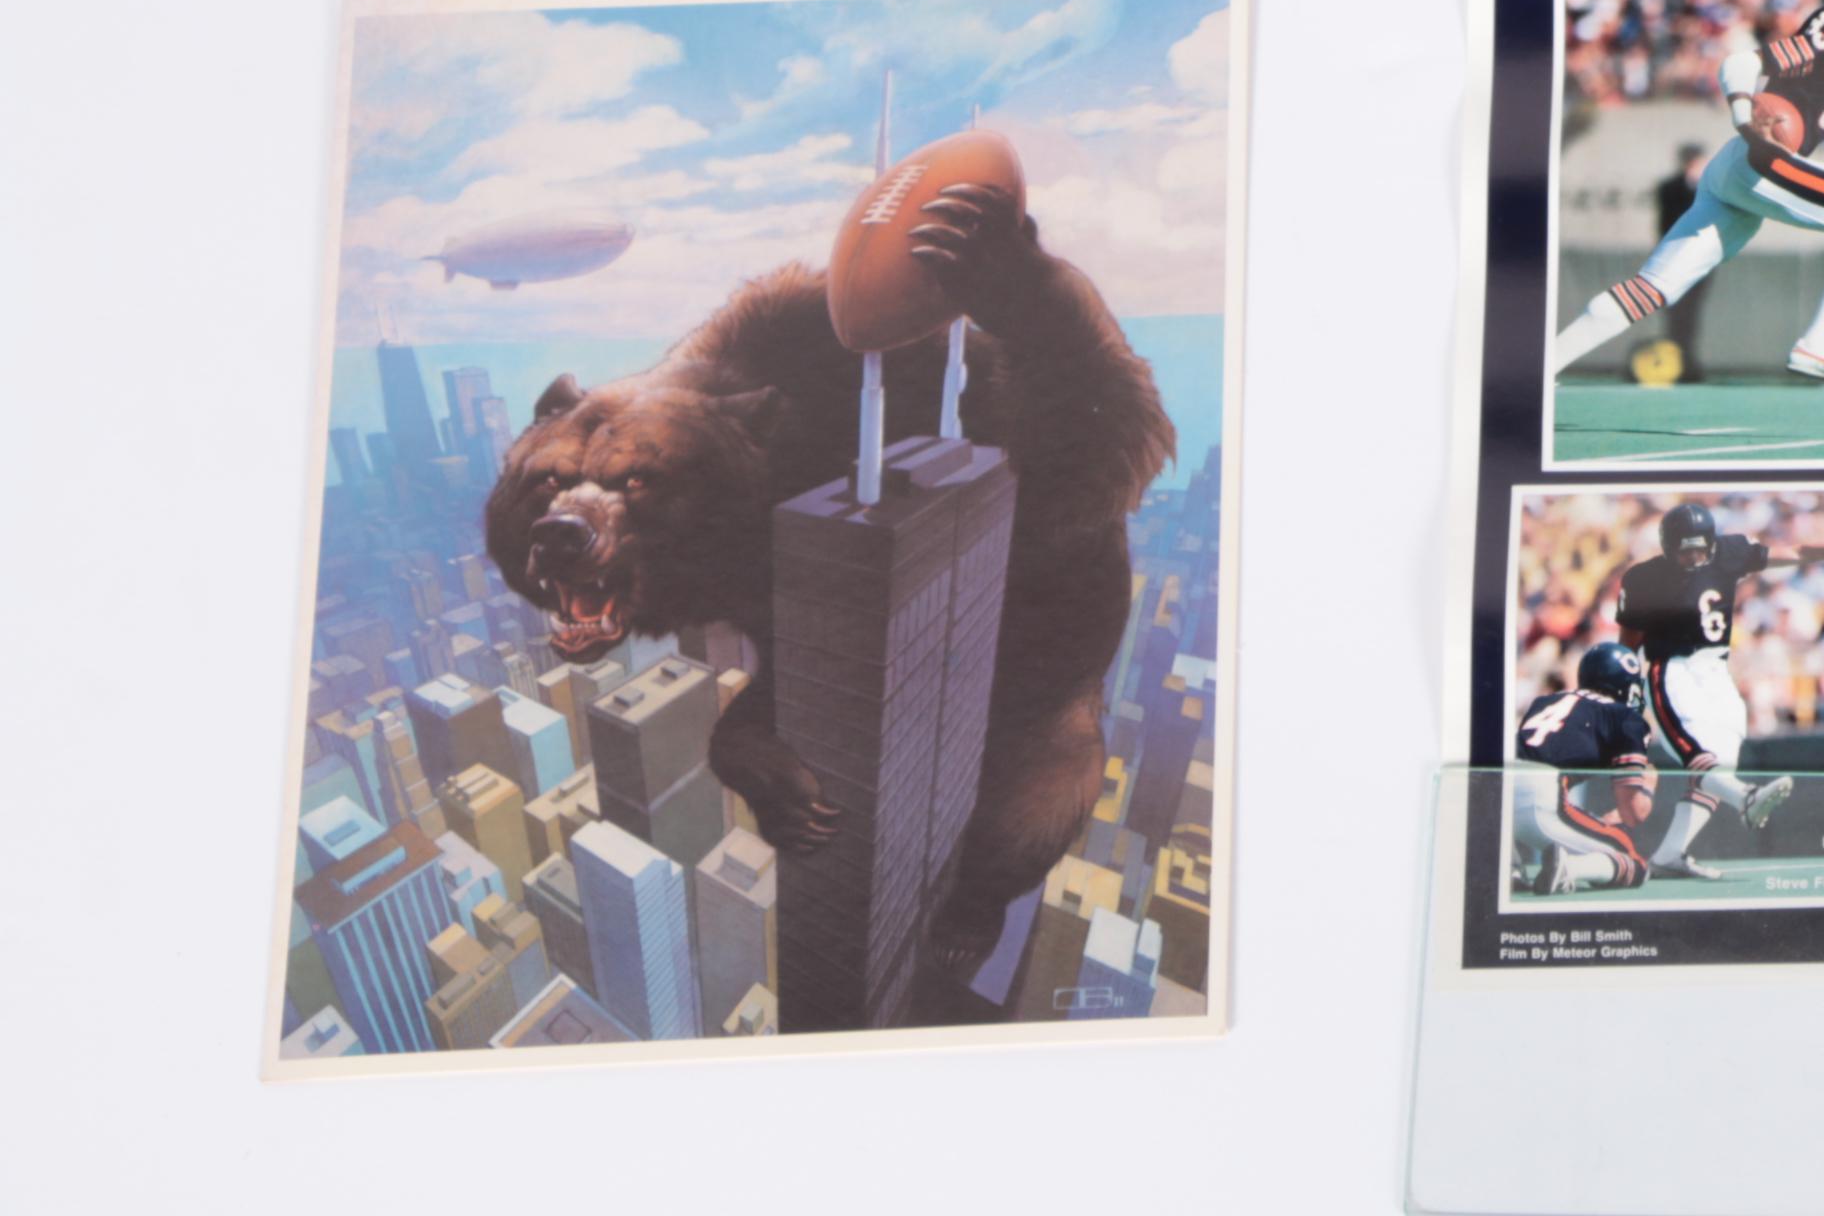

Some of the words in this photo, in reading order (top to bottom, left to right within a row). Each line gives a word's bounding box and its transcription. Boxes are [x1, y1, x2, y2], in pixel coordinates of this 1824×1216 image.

[1697, 588, 1727, 644] 6
[1520, 692, 1582, 748] 4
[1765, 876, 1809, 892] Steve
[1500, 930, 1546, 945] Photos
[1549, 930, 1567, 946] By
[1570, 929, 1592, 944] Bill
[1595, 928, 1633, 943] Smith
[1499, 946, 1528, 962] Film
[1531, 946, 1549, 962] By
[1552, 945, 1597, 960] Meteor
[1600, 944, 1659, 961] Graphics
